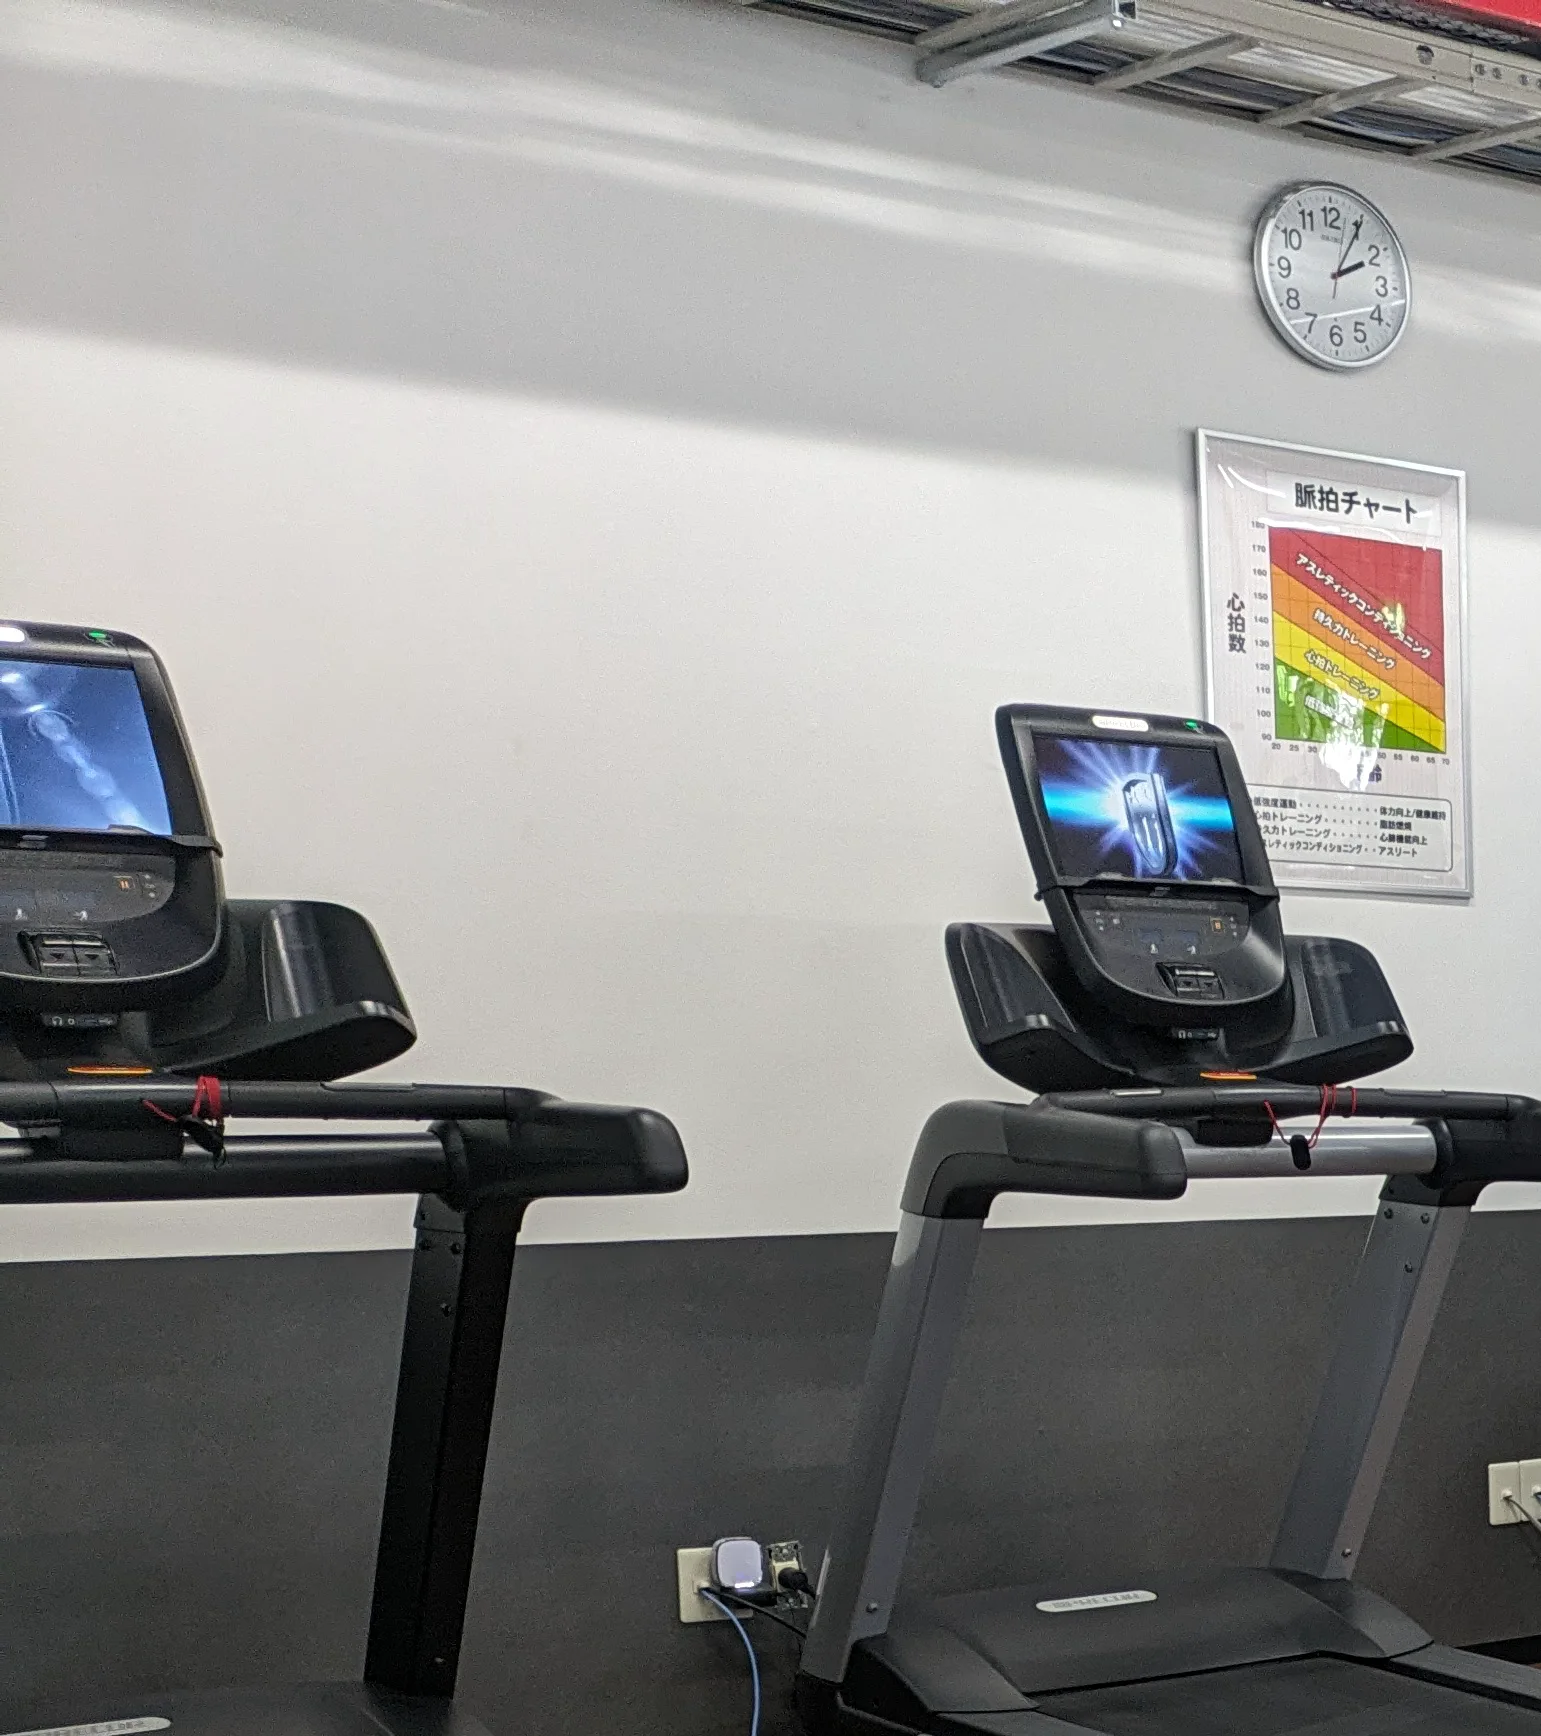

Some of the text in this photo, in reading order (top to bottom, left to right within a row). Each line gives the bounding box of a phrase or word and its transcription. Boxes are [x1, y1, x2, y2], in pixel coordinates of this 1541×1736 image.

[1299, 209, 1314, 231] 11
[1321, 206, 1341, 230] 12
[1281, 227, 1302, 250] 10
[1367, 244, 1380, 267] 2
[1277, 256, 1291, 278] 9
[1375, 276, 1388, 297] 3
[1286, 288, 1300, 310] 8
[1305, 312, 1318, 334] 7
[1369, 305, 1384, 326] 4
[1329, 324, 1343, 346] 6
[1353, 321, 1367, 343] 5
[1294, 482, 1417, 525] 脈拍チャート
[1252, 544, 1266, 553] 170
[1253, 568, 1267, 576] 160
[1253, 592, 1268, 601] 150
[1227, 592, 1246, 654] 心拍数
[1254, 616, 1269, 624] 140
[1255, 639, 1270, 648] 130
[1255, 663, 1270, 671] 120
[1304, 649, 1380, 700] 心拍トレーニング
[1256, 687, 1270, 695] 110
[1257, 710, 1271, 718] 100
[1262, 733, 1272, 741] 90
[1290, 744, 1300, 752] 25
[1308, 745, 1318, 753] 30
[1442, 757, 1450, 765] 70
[1260, 823, 1330, 838] 久力トレーニング
[1378, 846, 1418, 858] アスリート
